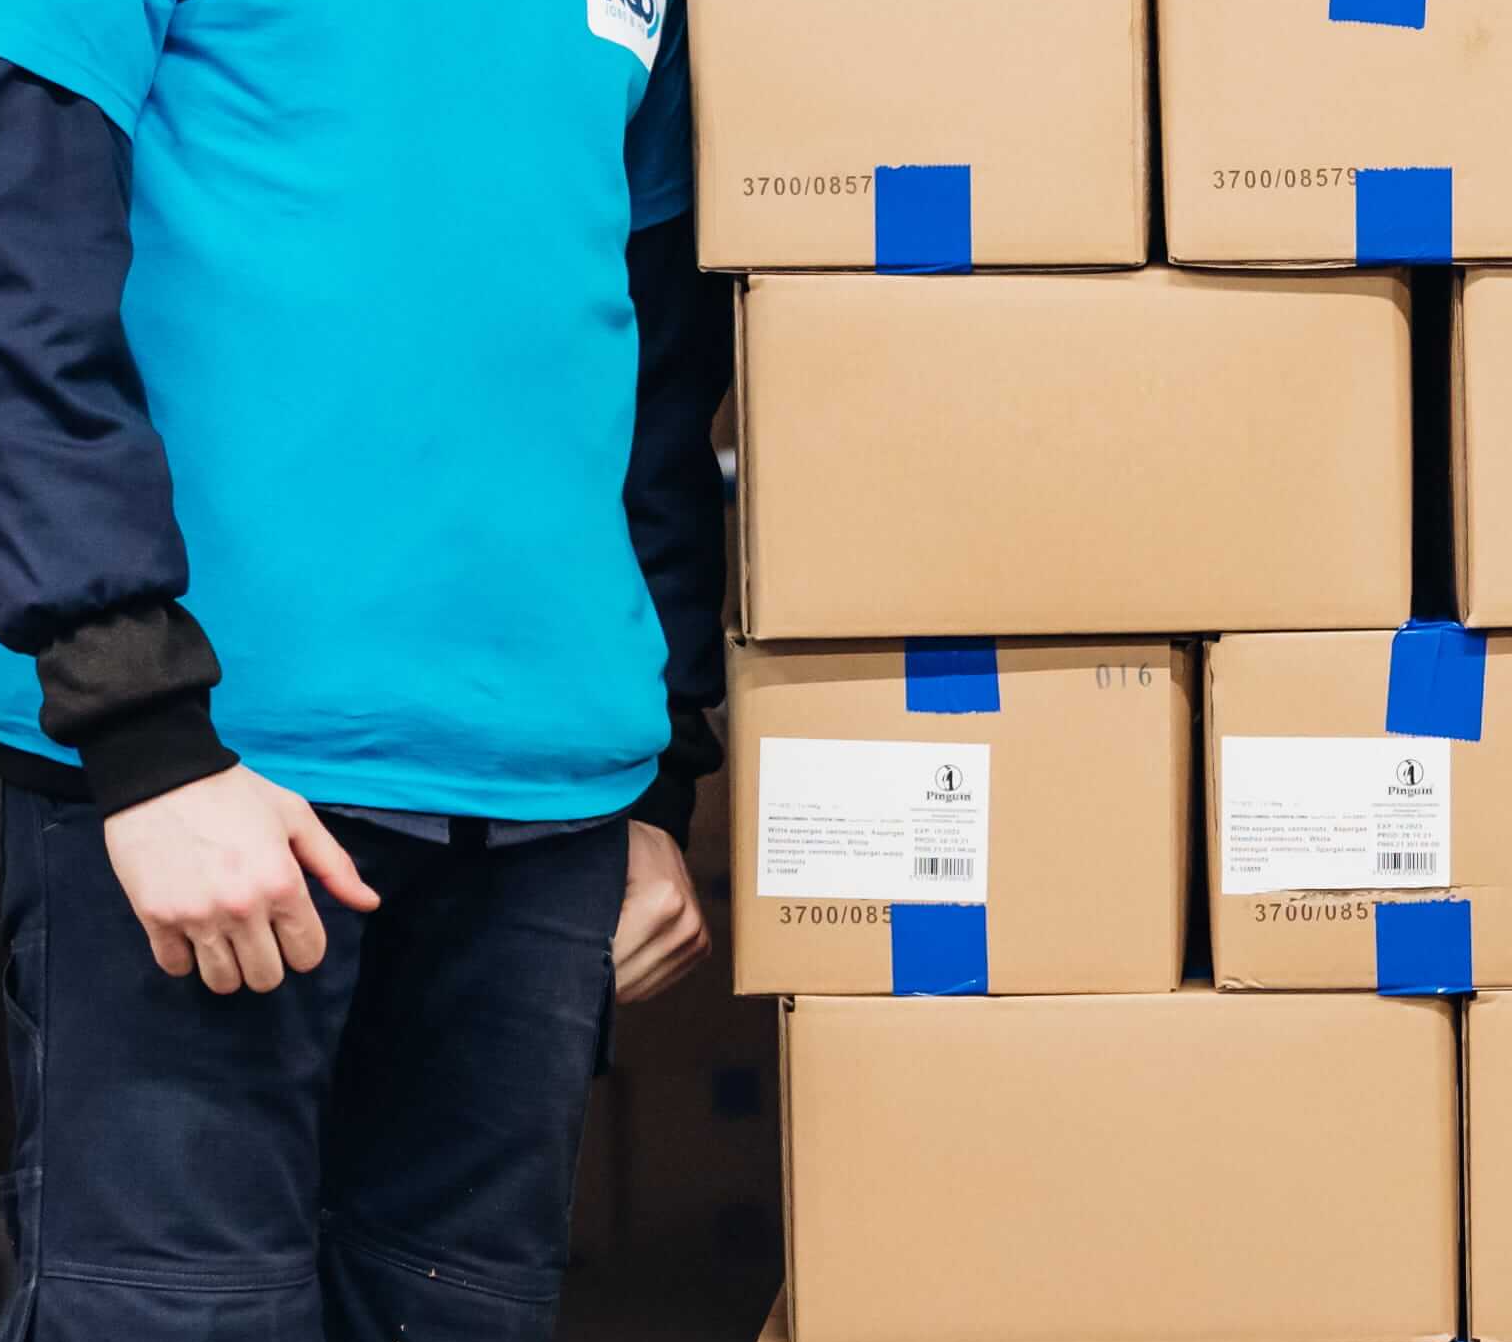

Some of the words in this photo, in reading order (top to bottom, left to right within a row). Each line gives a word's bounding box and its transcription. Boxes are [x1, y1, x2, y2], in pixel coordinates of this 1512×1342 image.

[743, 175, 873, 197] 3700/0857
[1096, 662, 1153, 690] 016
[926, 790, 971, 803] Pinguin
[1387, 786, 1433, 797] Pinguin
[779, 905, 894, 926] 3700/085
